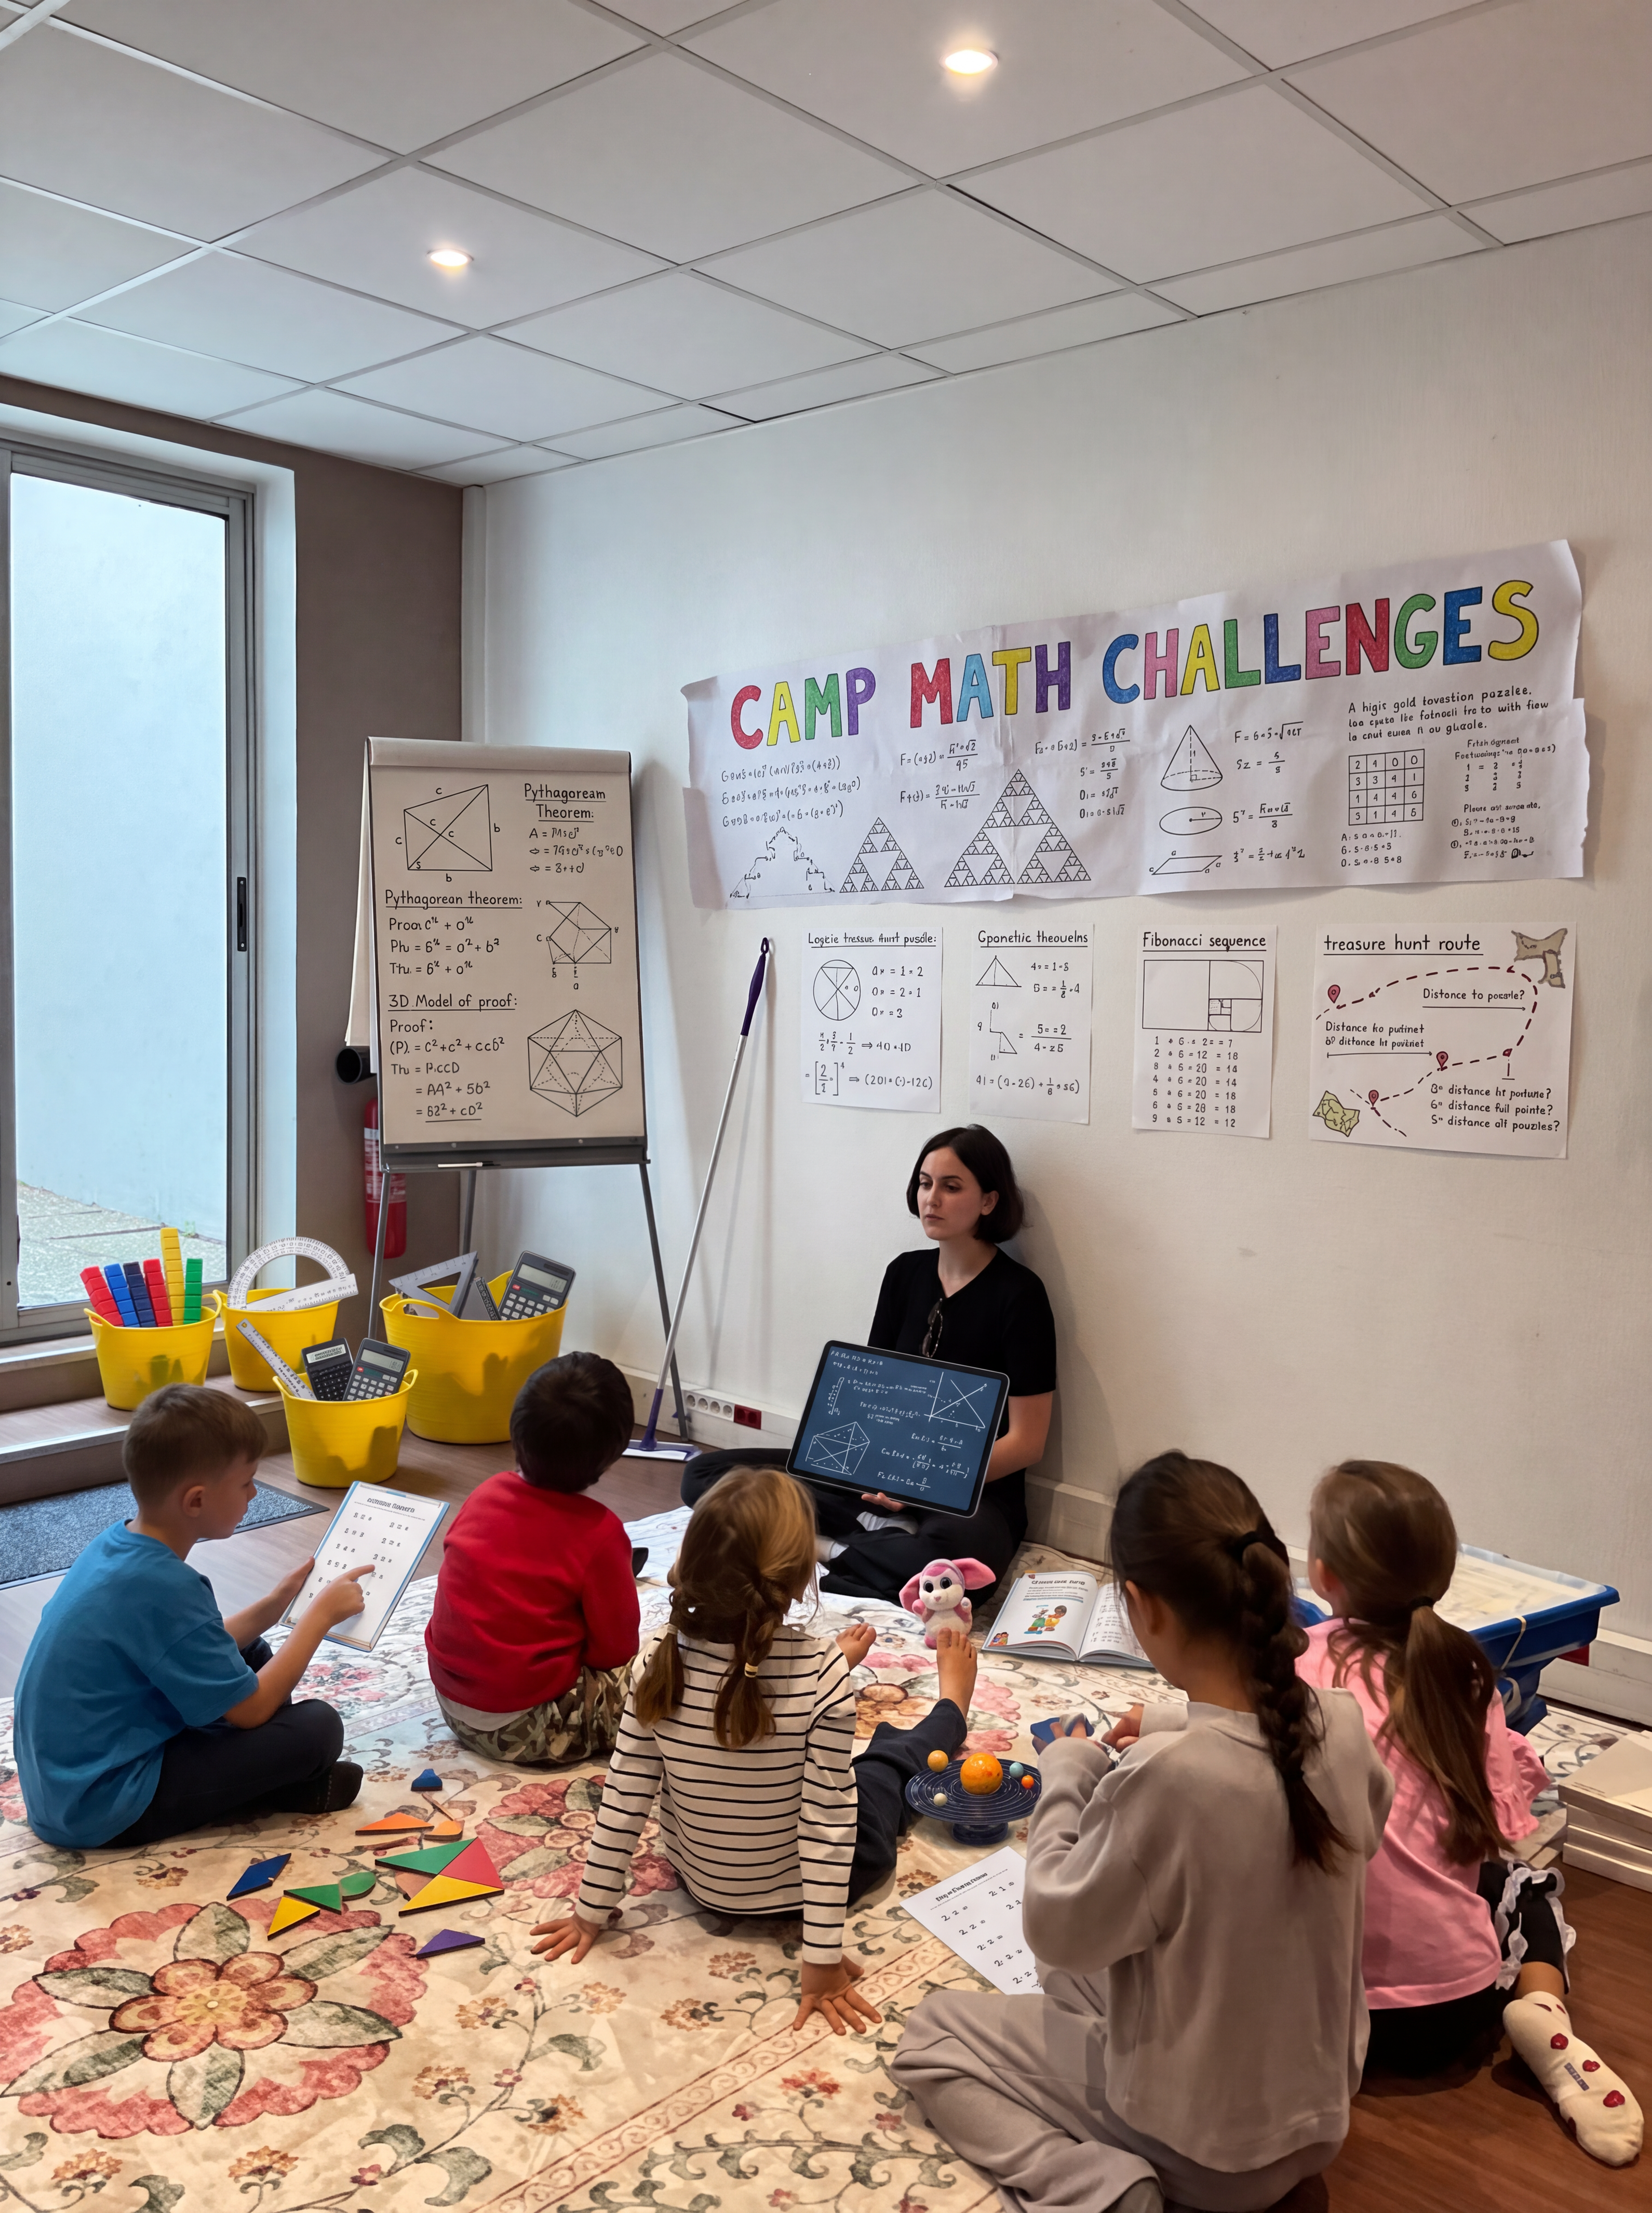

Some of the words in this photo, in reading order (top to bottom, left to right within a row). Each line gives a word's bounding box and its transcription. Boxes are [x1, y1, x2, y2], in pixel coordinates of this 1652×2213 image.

[731, 667, 876, 749] CAMP
[910, 644, 1071, 728] MATH
[1102, 580, 1539, 704] CHALLENGES
[1348, 702, 1356, 714] A
[1393, 696, 1416, 713] gold
[1498, 701, 1521, 713] with
[1355, 760, 1360, 769] 2
[1356, 777, 1361, 786] 3
[1373, 775, 1378, 784] 3
[1411, 790, 1417, 799] 6
[535, 804, 594, 818] Theorem:
[494, 822, 501, 833] b
[529, 828, 538, 839] A
[446, 873, 452, 882] b
[385, 890, 462, 910] Pythagorean
[468, 890, 522, 905] theorem:
[1143, 931, 1202, 947] Fibonacci
[1210, 937, 1266, 952] sequence
[1324, 935, 1386, 951] treasure
[1395, 933, 1430, 950] hunt
[1439, 934, 1480, 951] route
[917, 966, 923, 977] 2
[900, 987, 905, 997] 2
[1471, 989, 1483, 1000] to
[458, 994, 472, 1007] of
[479, 993, 517, 1012] proof:
[897, 1008, 903, 1018] 3
[390, 1018, 433, 1032] Proof:
[1326, 1021, 1367, 1032] Distance
[1155, 1035, 1159, 1045] 1
[1179, 1037, 1184, 1046] 6
[1203, 1038, 1208, 1046] 2
[1228, 1039, 1233, 1048] 7
[1154, 1048, 1160, 1057] 2
[1178, 1050, 1184, 1058] 6
[1197, 1050, 1207, 1059] 12
[1227, 1052, 1238, 1060] 18
[1154, 1062, 1158, 1070] 8
[1178, 1063, 1184, 1071] 6
[1153, 1074, 1158, 1083] 4
[1178, 1076, 1183, 1084] 6
[1196, 1076, 1207, 1087] 20
[1226, 1078, 1237, 1087] 14
[1195, 1089, 1206, 1100] 20
[1226, 1092, 1236, 1100] 18
[1448, 1084, 1491, 1096] distance
[1152, 1101, 1158, 1109] 6
[1225, 1105, 1236, 1113] 18
[1448, 1100, 1491, 1112] distance
[1515, 1104, 1553, 1117] pointe?
[1152, 1114, 1157, 1123] 9
[1195, 1116, 1205, 1126] 12
[1225, 1118, 1235, 1128] 12
[1447, 1115, 1490, 1128] distance
